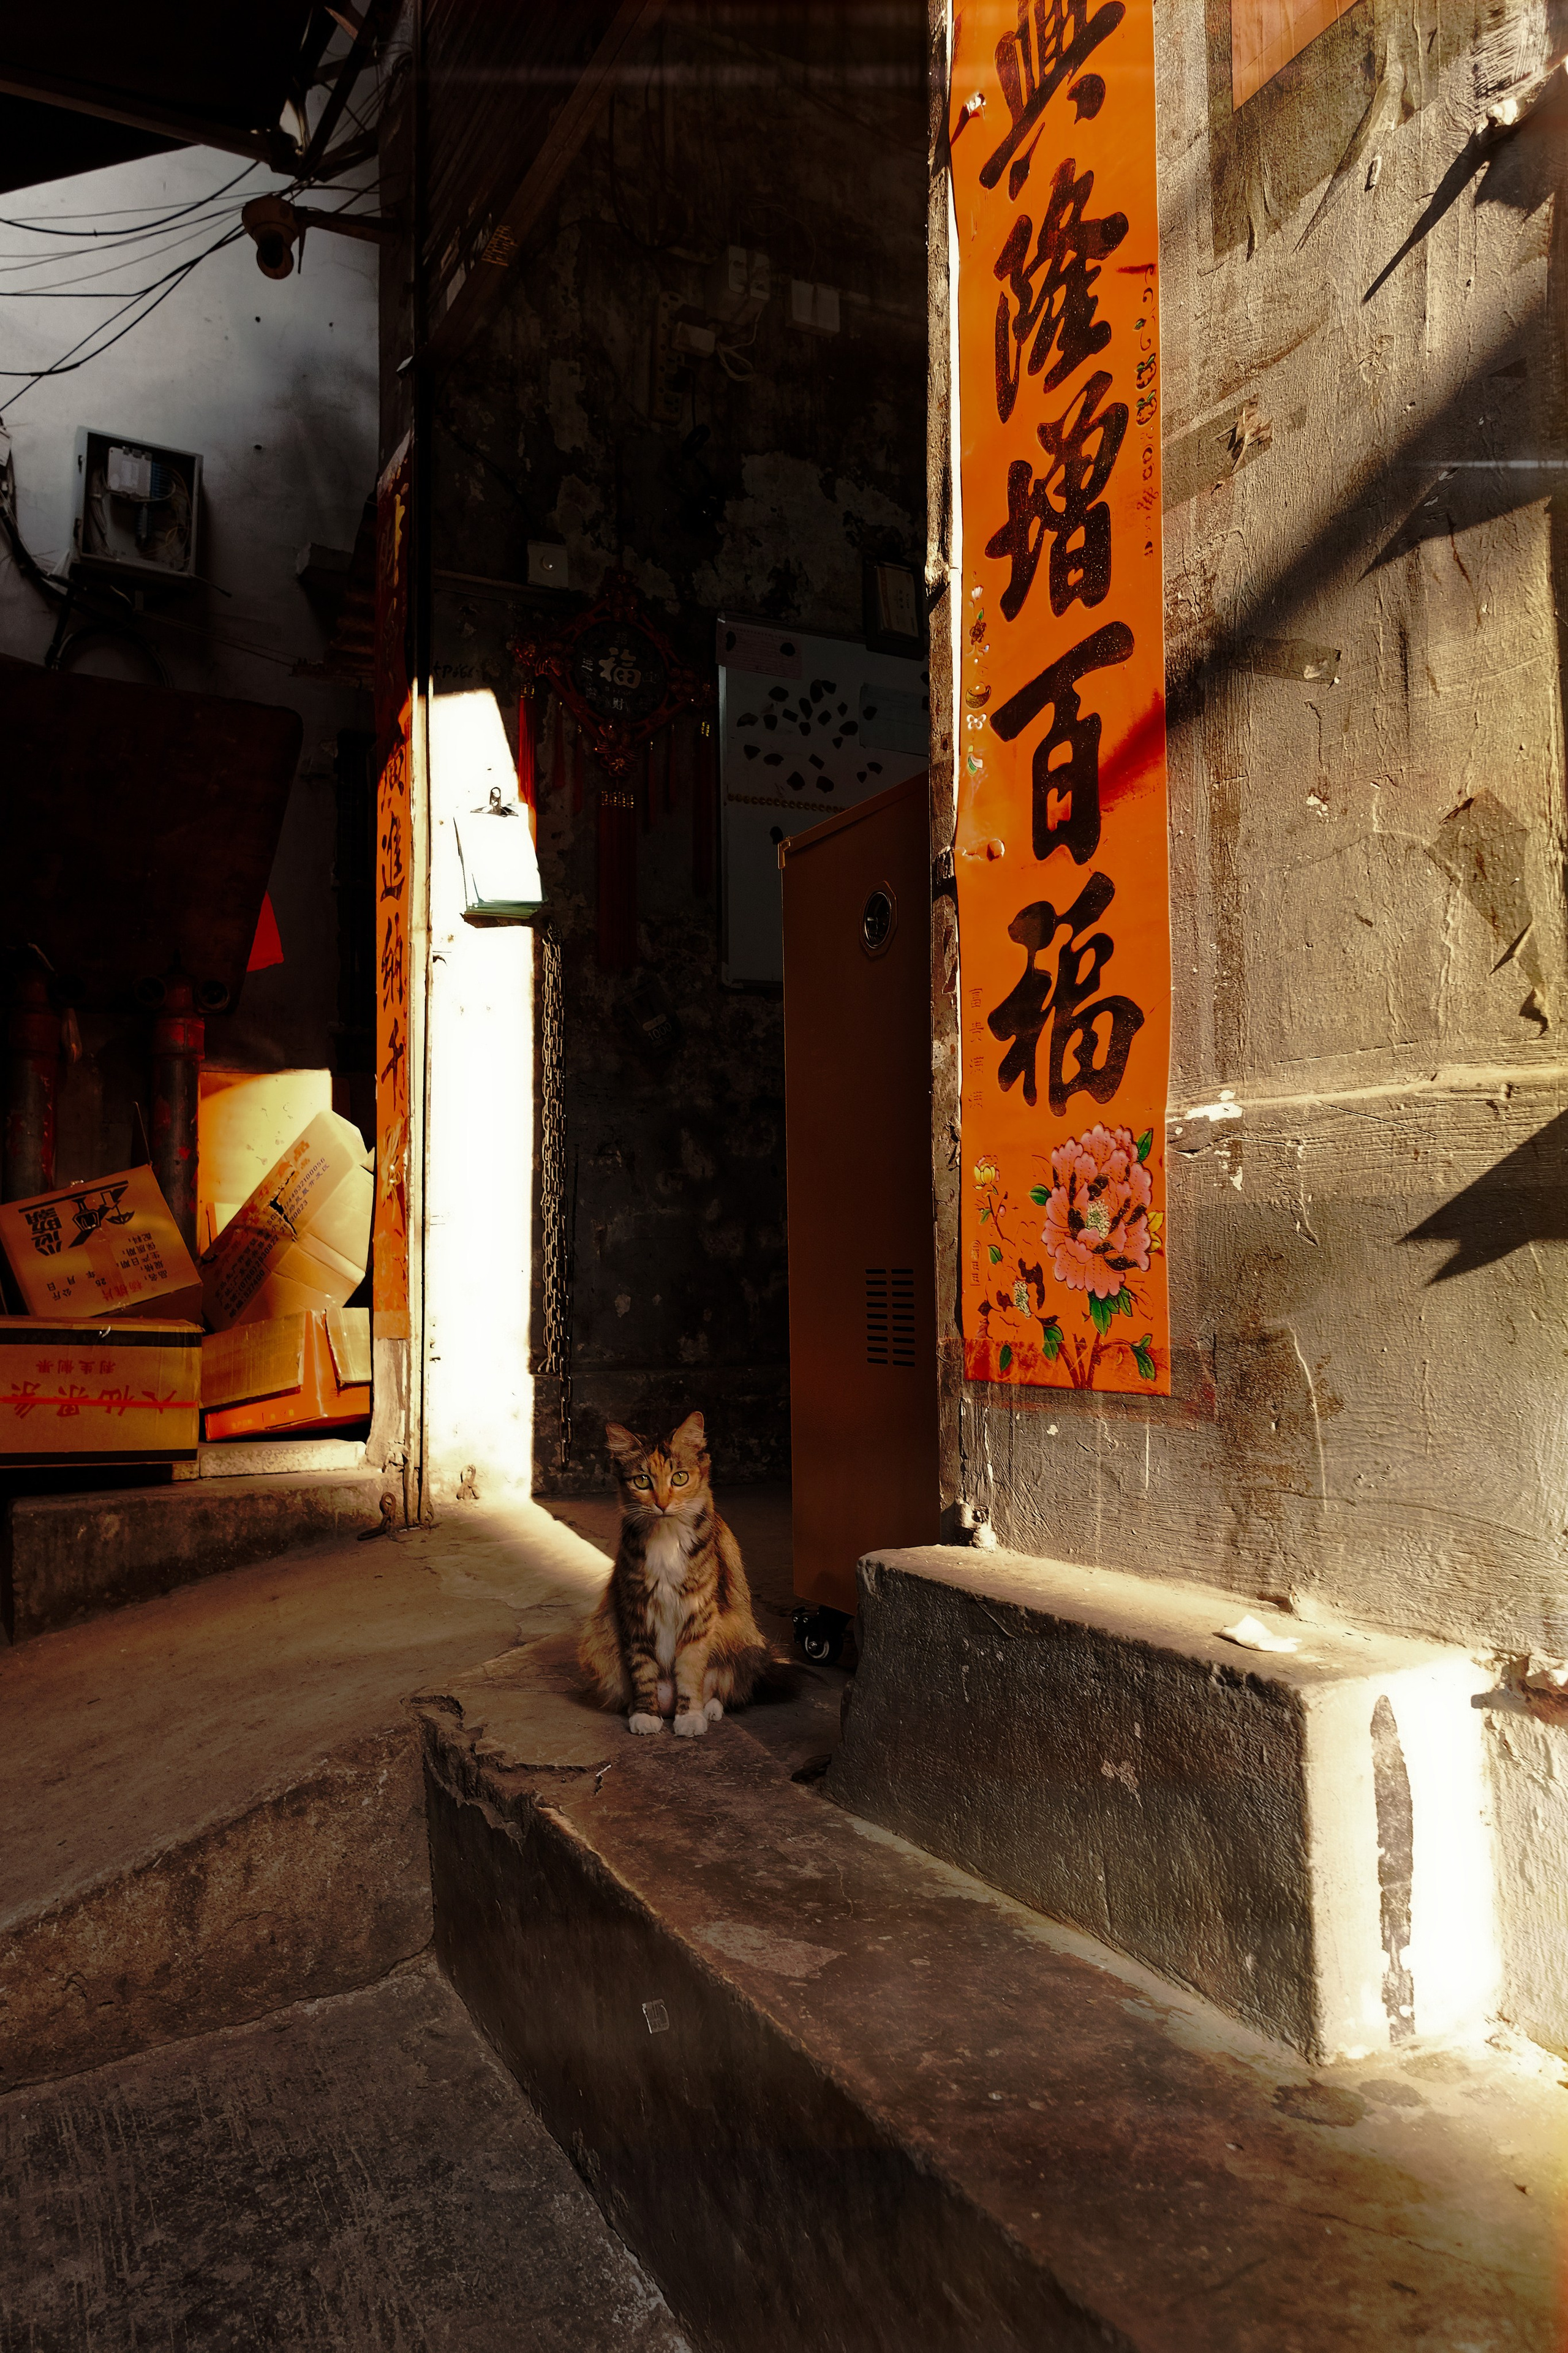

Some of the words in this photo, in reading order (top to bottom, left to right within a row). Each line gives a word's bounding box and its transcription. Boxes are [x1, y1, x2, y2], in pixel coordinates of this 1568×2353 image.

[598, 647, 642, 689] 福
[647, 1022, 673, 1041] 1000
[66, 1275, 76, 1285] 月
[85, 1269, 96, 1280] 年
[47, 1282, 56, 1291] 日
[95, 1278, 107, 1287] 25
[51, 1287, 72, 1301] 公斤
[102, 1280, 143, 1302] 杨桃片
